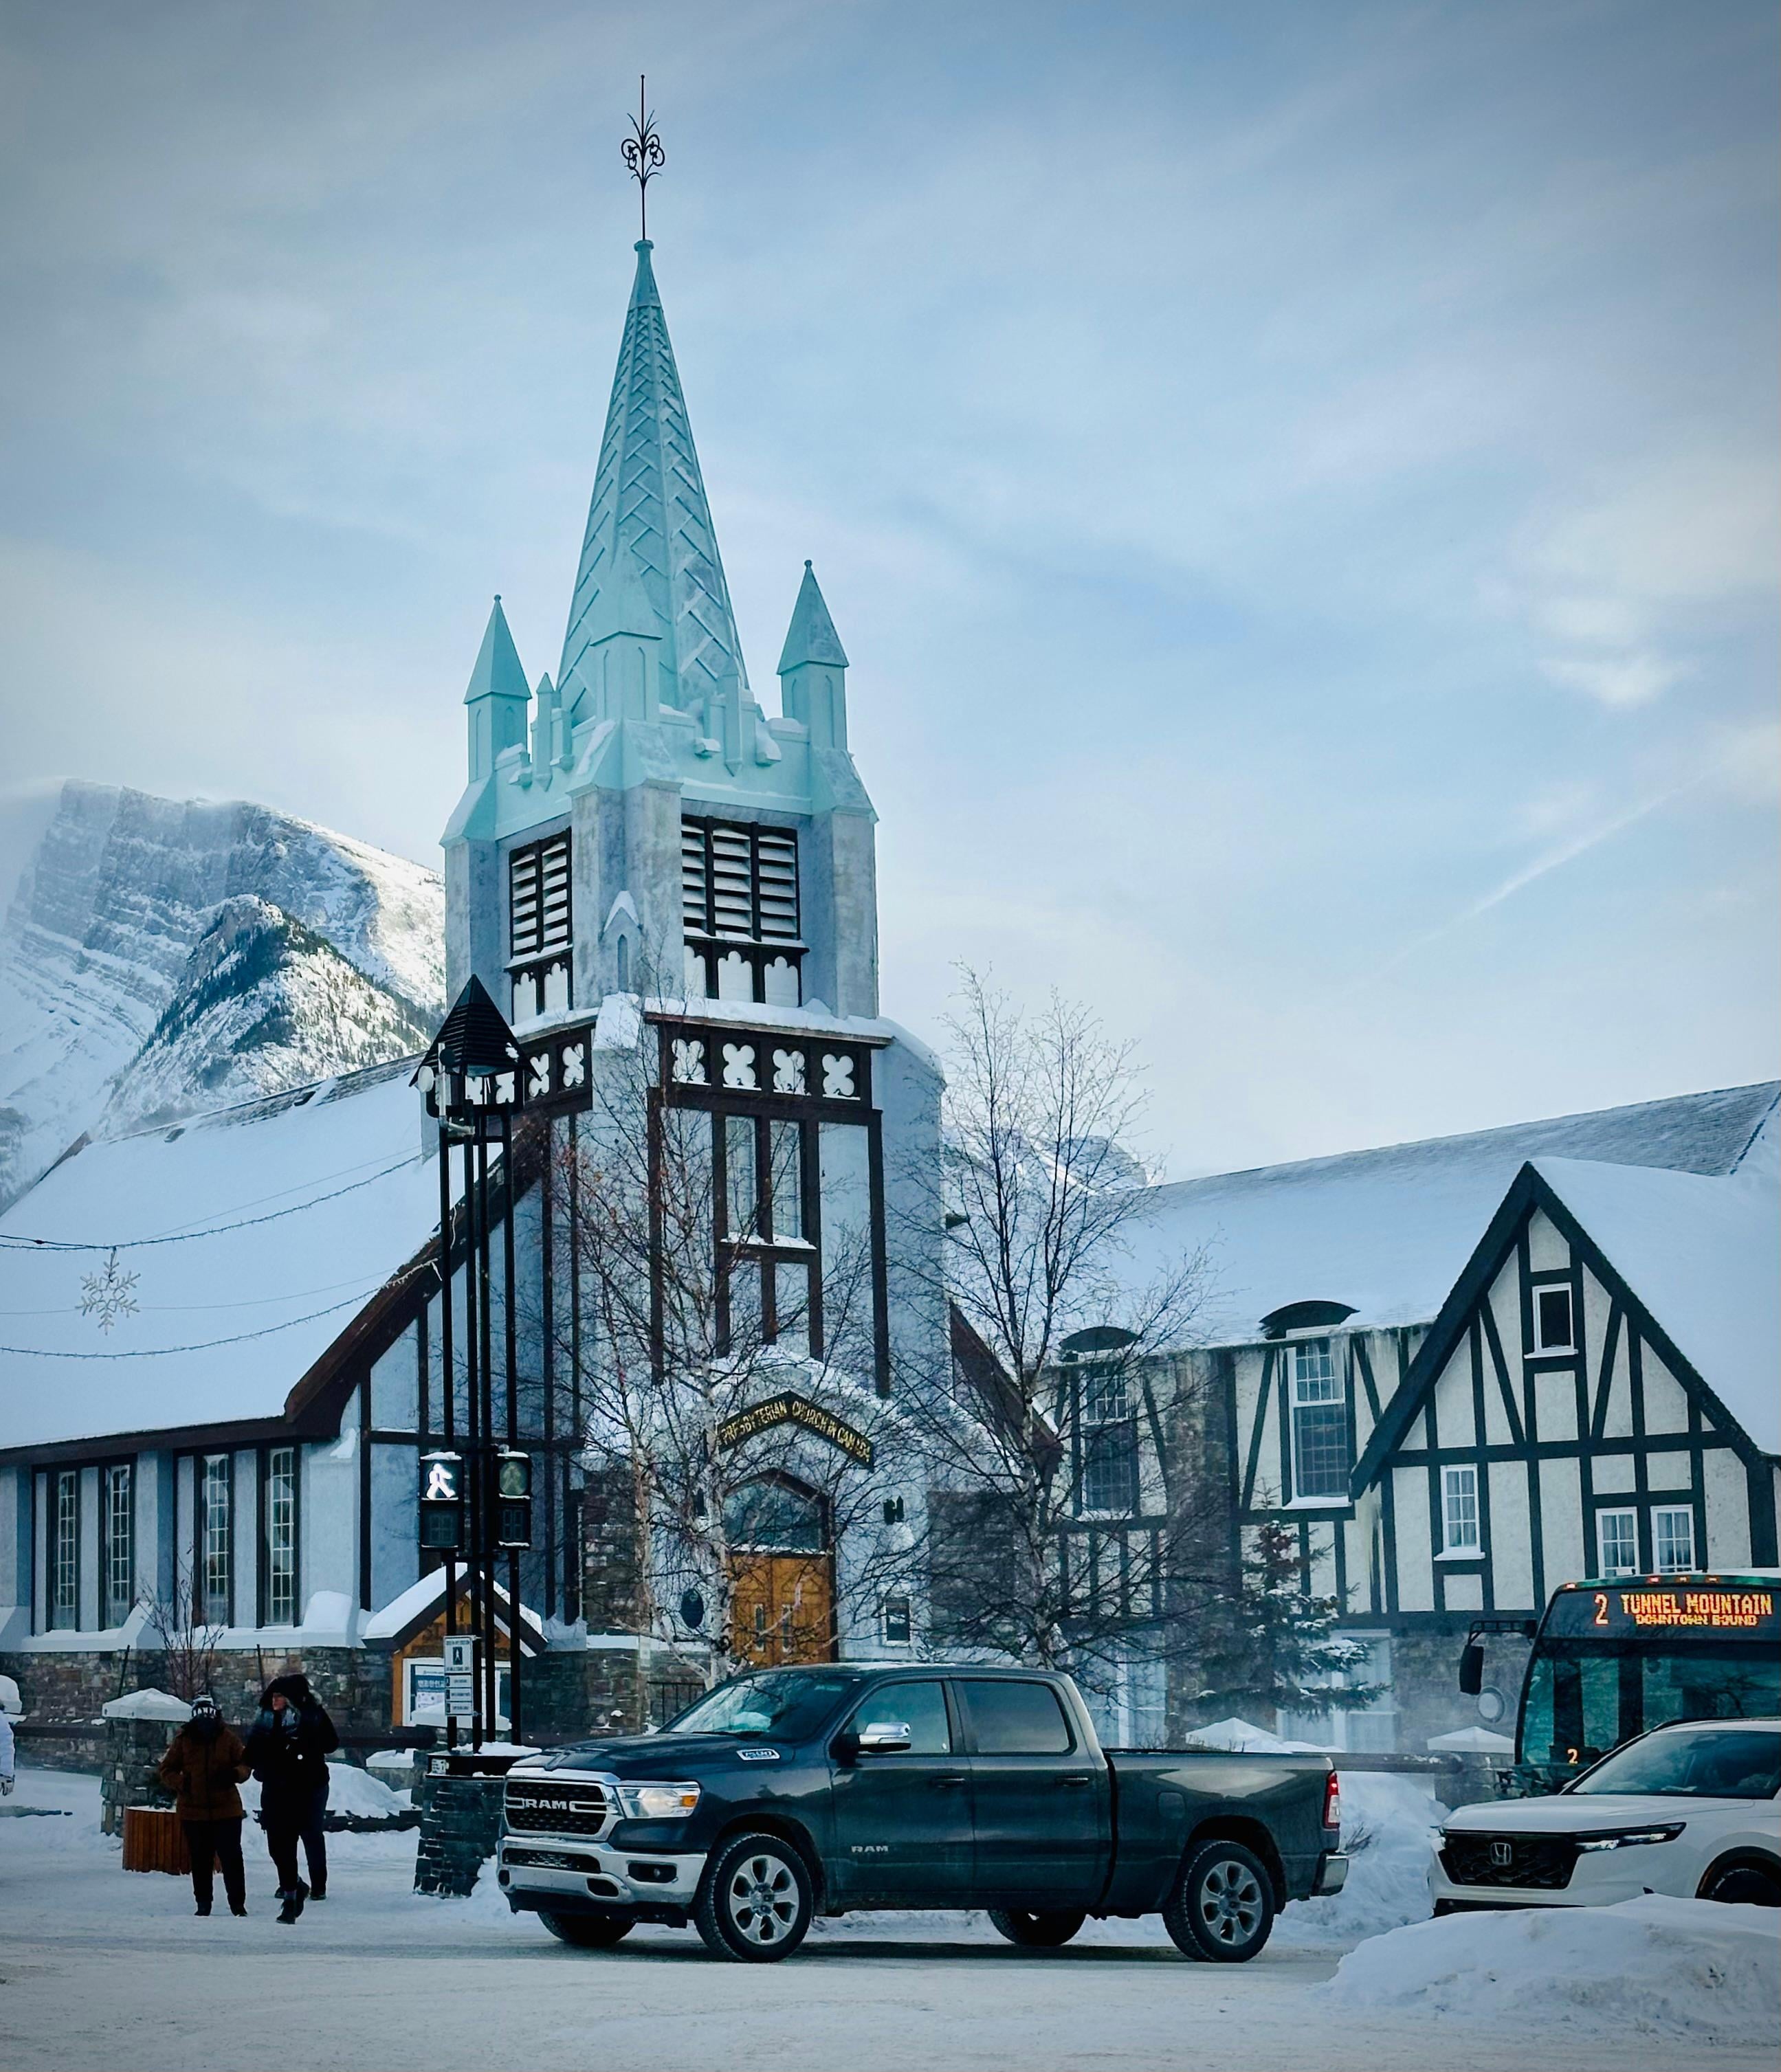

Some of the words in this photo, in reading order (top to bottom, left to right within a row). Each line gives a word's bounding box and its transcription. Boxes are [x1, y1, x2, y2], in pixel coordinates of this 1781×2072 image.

[1594, 1594, 1608, 1625] 2
[1620, 1594, 1681, 1614] TUNNEL
[1685, 1594, 1772, 1615] MOUNTAIN
[1635, 1614, 1709, 1625] DOWNTOWN
[1712, 1614, 1758, 1626] BOUND
[1567, 1748, 1578, 1764] 2
[525, 1798, 567, 1809] RAM
